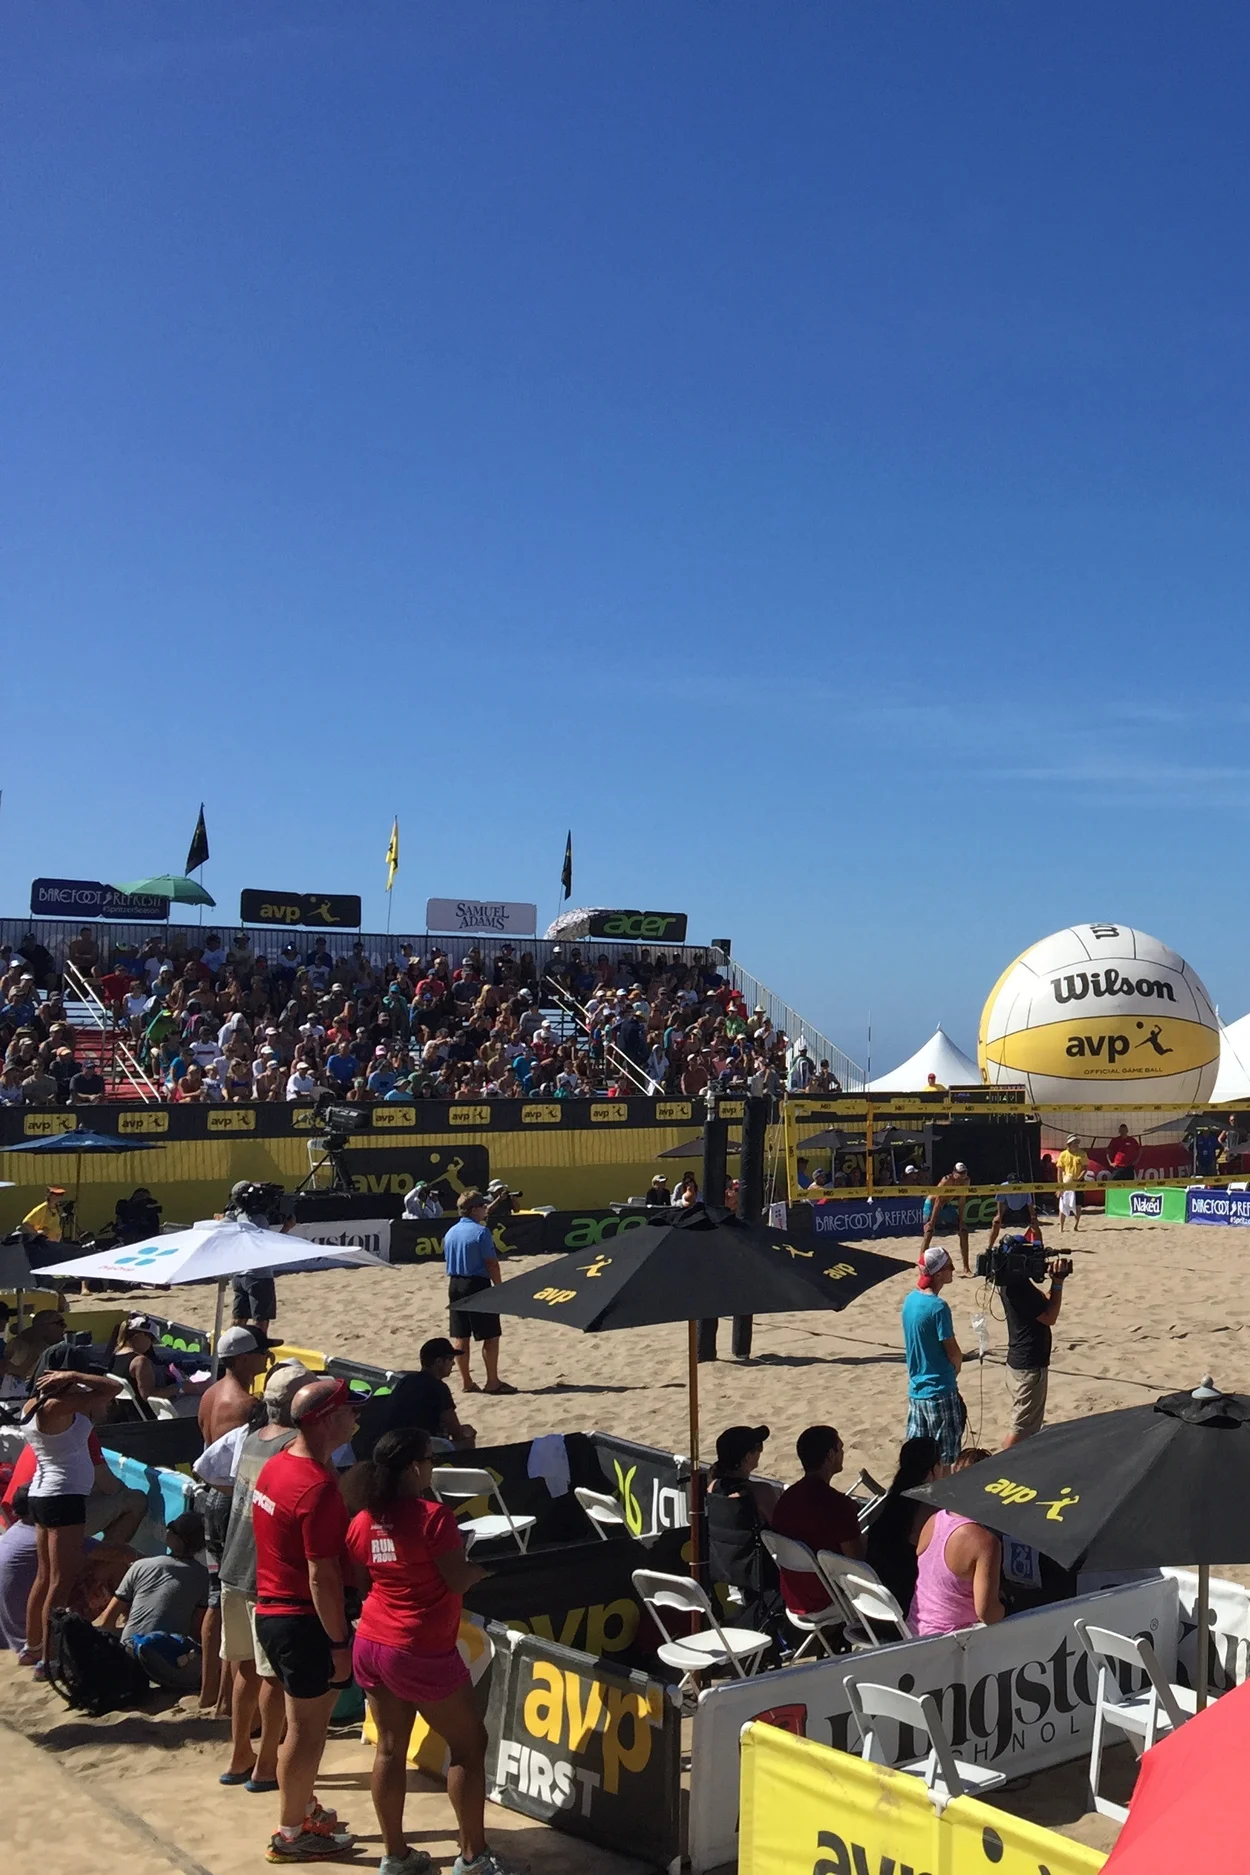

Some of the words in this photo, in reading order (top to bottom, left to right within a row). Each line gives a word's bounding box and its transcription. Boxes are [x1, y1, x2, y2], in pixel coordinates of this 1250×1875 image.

[38, 887, 103, 904] BAREFOOT
[260, 903, 300, 924] avp
[455, 902, 510, 920] SAMUEL
[458, 915, 506, 931] ADAMS
[603, 913, 678, 937] acer
[1050, 968, 1177, 1004] Wilson
[1065, 1034, 1130, 1064] avp
[1083, 1067, 1120, 1075] OFFICIAL
[1121, 1066, 1144, 1074] GAME
[375, 1114, 395, 1123] avp
[452, 1112, 470, 1121] avp
[524, 1110, 542, 1120] avp
[592, 1109, 609, 1119] avp
[658, 1107, 674, 1118] avp
[721, 1106, 737, 1117] avp
[27, 1118, 52, 1132] avp
[122, 1117, 144, 1130] avp
[211, 1116, 232, 1129] avp
[1133, 1197, 1160, 1213] Naked
[1191, 1197, 1230, 1215] BAREFOOT
[815, 1212, 873, 1232] BAREFOOT
[883, 1208, 923, 1226] REFRESH
[415, 1237, 445, 1255] av
[823, 1262, 857, 1281] avp
[533, 1286, 577, 1306] avp
[984, 1476, 1038, 1506] avp
[370, 1538, 395, 1553] RUN
[523, 1660, 652, 1796] avp
[496, 1739, 600, 1818] FIRST
